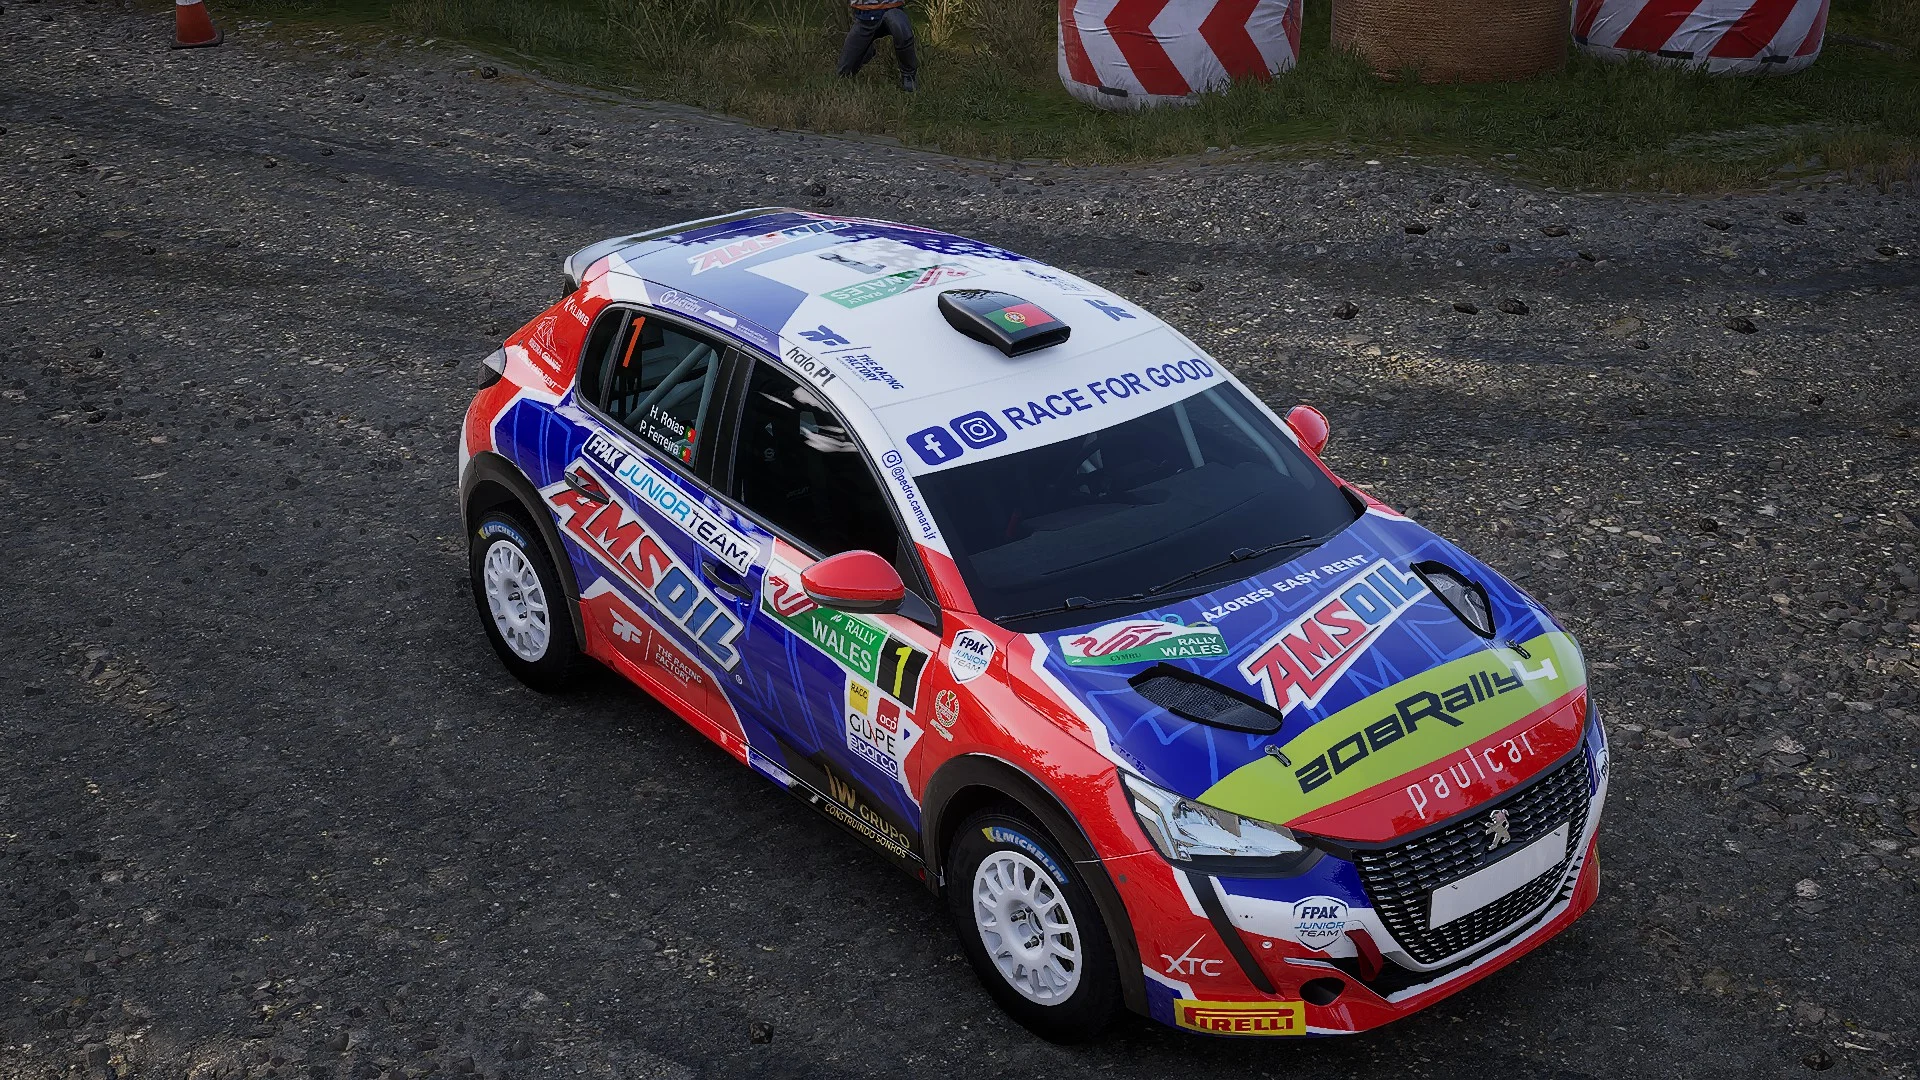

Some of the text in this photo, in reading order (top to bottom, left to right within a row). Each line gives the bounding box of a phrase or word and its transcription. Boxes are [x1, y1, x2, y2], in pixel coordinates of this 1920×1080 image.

[688, 220, 851, 275] AMSOIL
[830, 275, 910, 300] WALES
[622, 316, 646, 368] 1
[786, 346, 836, 388] halo.P1
[842, 355, 881, 382] FACTORY
[650, 404, 659, 420] H.
[1002, 357, 1215, 431] RACE FOR GOOD
[640, 420, 680, 455] P. Ferreira
[587, 434, 749, 566] FPAK JUNIOR TEAM
[547, 464, 744, 668] AMSOIL
[1202, 554, 1369, 622] AZORES EASY RENT
[811, 616, 872, 673] WALES
[845, 621, 878, 646] RALLY
[959, 636, 988, 656] FPAK
[1160, 644, 1223, 657] WALES
[1178, 636, 1217, 646] RALLY
[1244, 563, 1427, 713] AMSOIL
[655, 652, 691, 683] FACTORY
[657, 644, 673, 661] THE
[673, 657, 702, 684] RACING
[892, 645, 913, 699] 1
[952, 650, 987, 667] JUNIOR
[850, 682, 868, 699] RACC
[1406, 731, 1534, 819] paulcar
[824, 803, 907, 858] CONSTRUINDO SONHOS
[859, 804, 910, 848] GRUPO
[1002, 831, 1065, 883] MICHELIN
[1294, 921, 1346, 930] JUNIOR
[1301, 905, 1339, 919] FPAK
[1299, 929, 1340, 938] TEAM
[1160, 933, 1224, 977] XTC
[1184, 1005, 1295, 1032] PIRELLI
